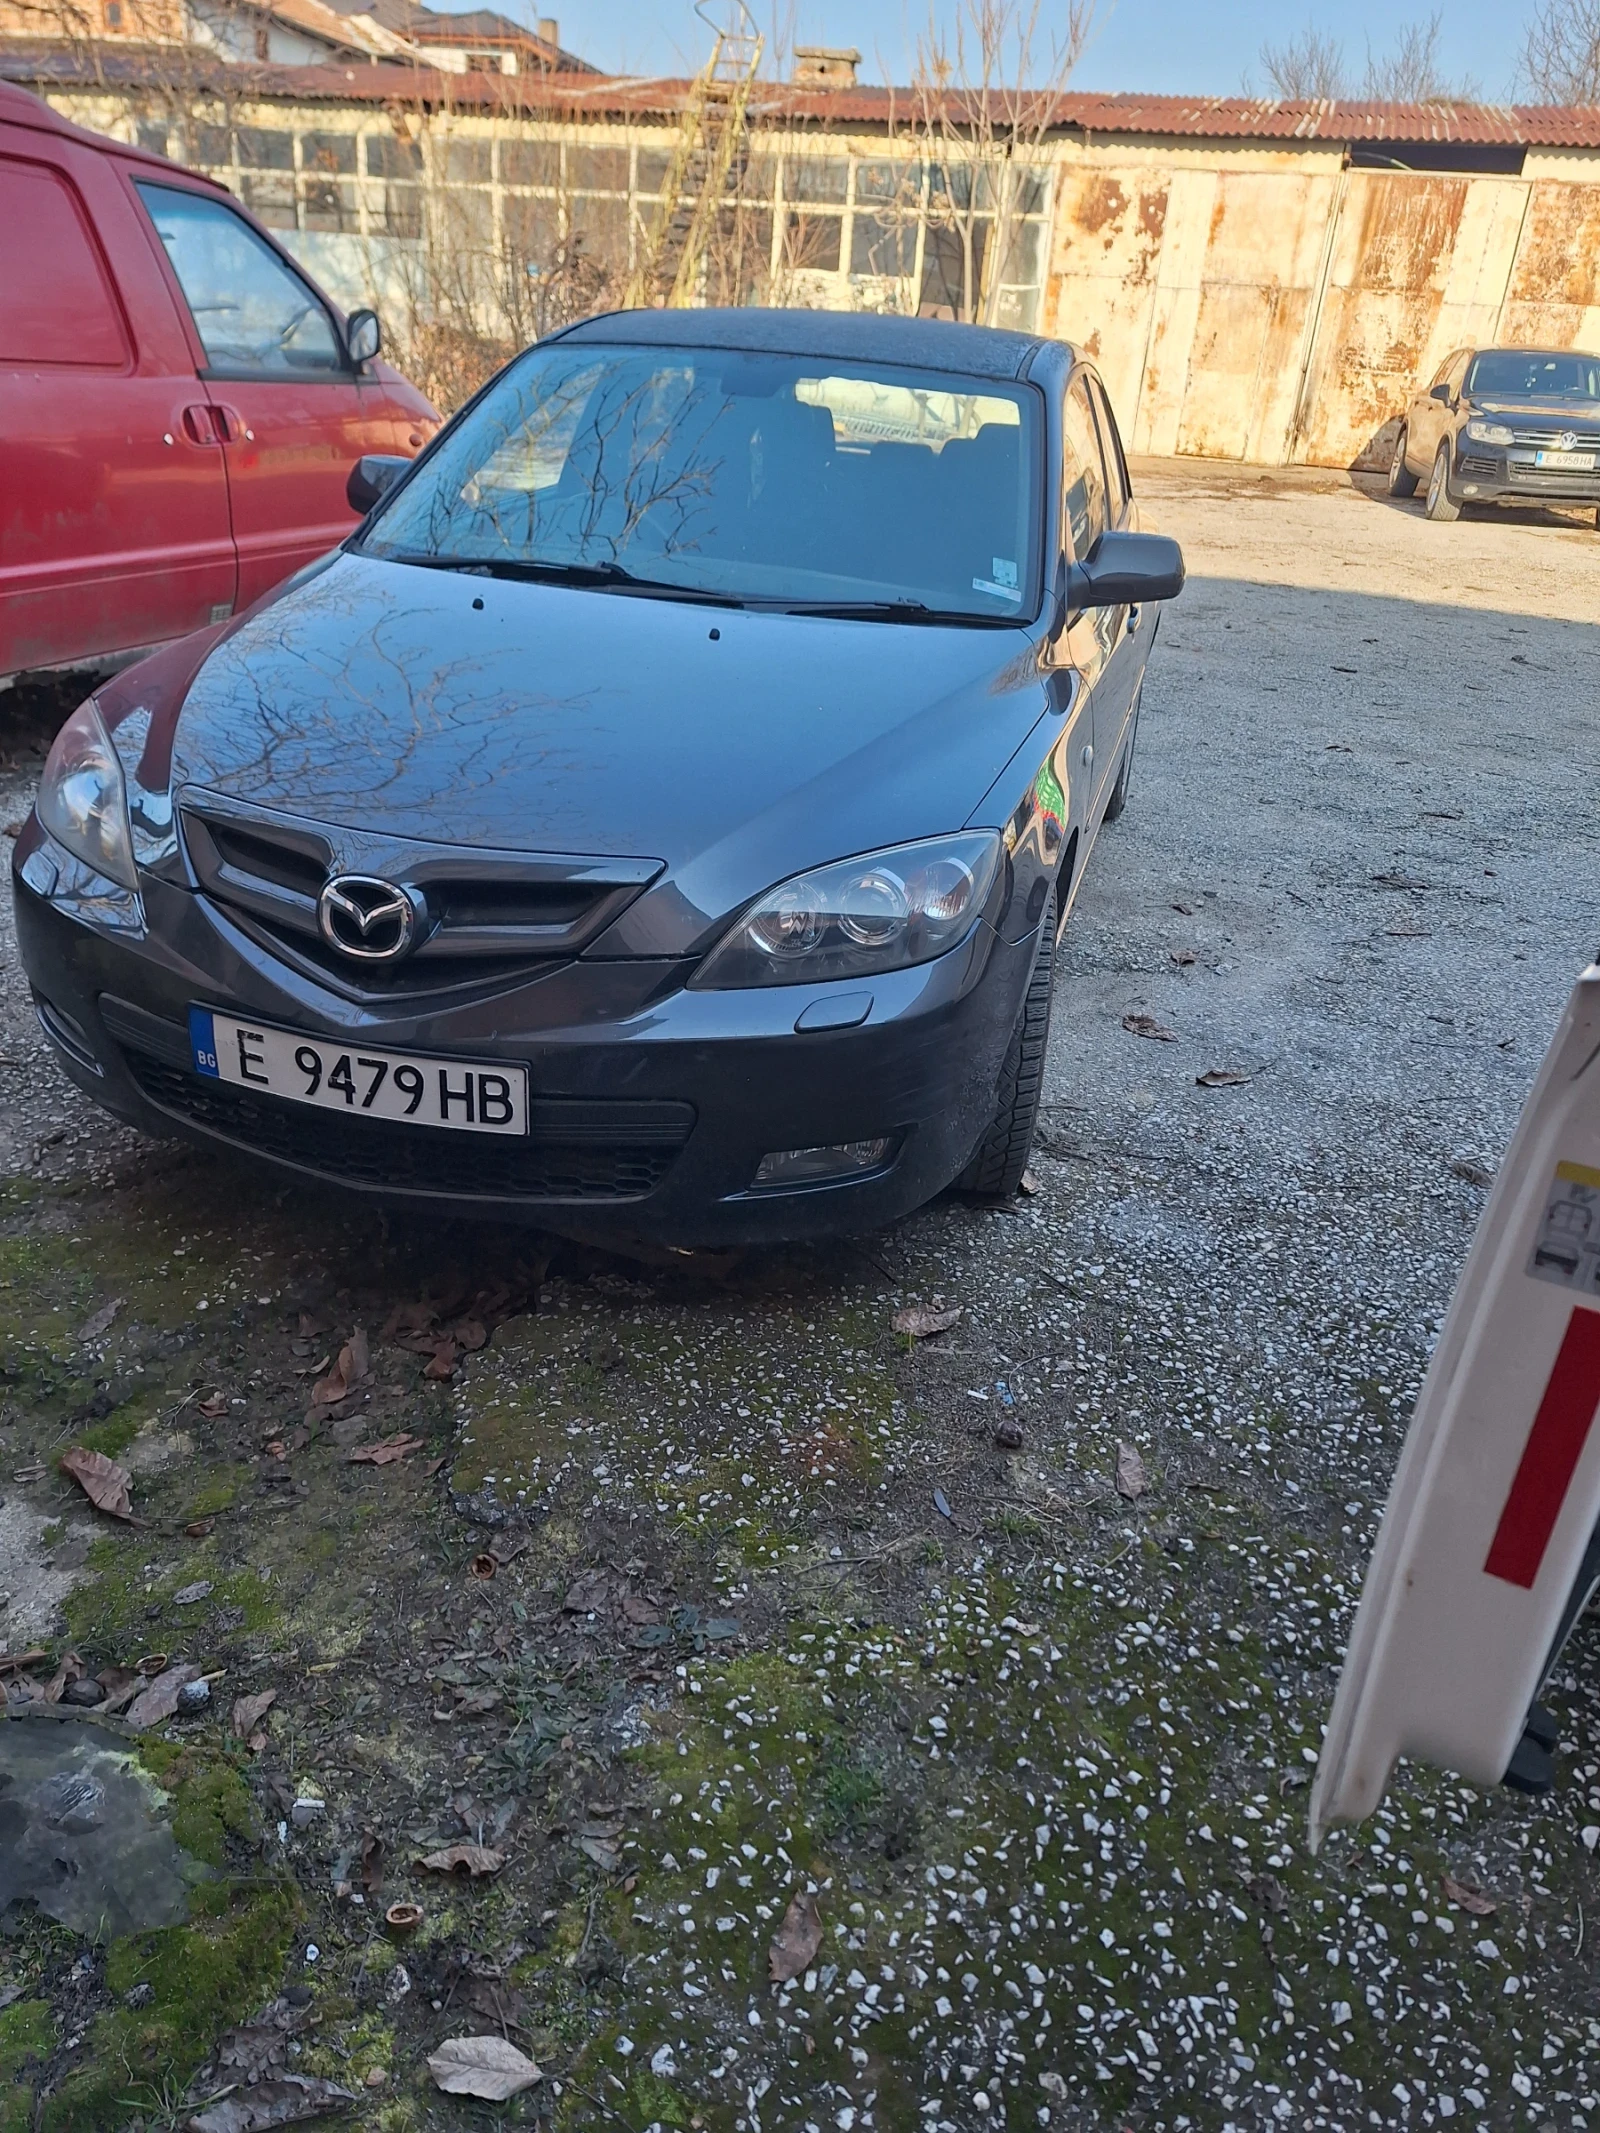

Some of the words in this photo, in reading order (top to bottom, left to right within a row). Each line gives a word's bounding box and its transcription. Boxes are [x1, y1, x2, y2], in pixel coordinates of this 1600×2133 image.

[1545, 454, 1553, 464] E
[197, 1049, 217, 1068] BG
[236, 1028, 270, 1086] E
[294, 1045, 425, 1115] 9479
[438, 1067, 514, 1126] HB
